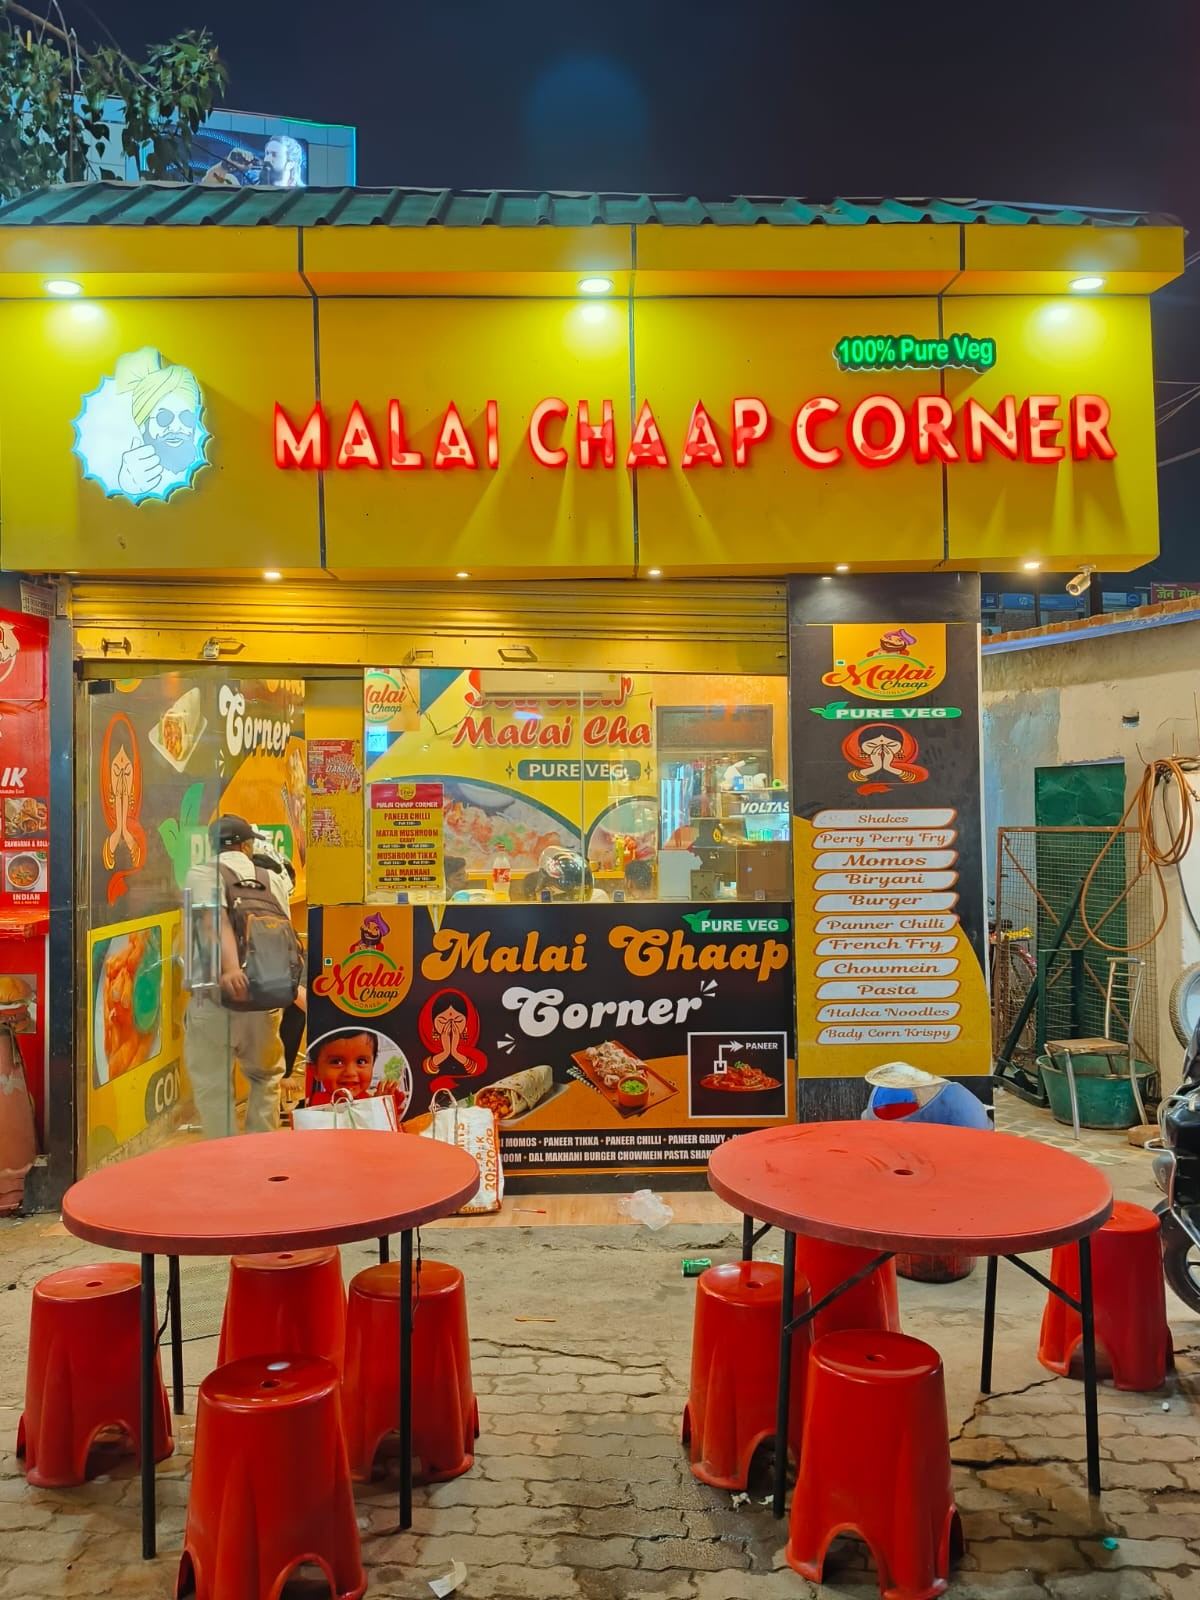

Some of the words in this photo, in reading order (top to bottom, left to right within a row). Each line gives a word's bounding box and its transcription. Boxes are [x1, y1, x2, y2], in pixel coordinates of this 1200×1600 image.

[839, 338, 895, 363] 100%
[901, 338, 949, 361] Pure
[953, 337, 993, 366] Veg
[273, 399, 499, 470] MALAI
[529, 397, 768, 470] CHAAP
[791, 393, 1117, 470] CORNER
[825, 664, 937, 690] Malai
[880, 679, 930, 691] Chaap
[371, 703, 402, 715] Chaap
[836, 708, 894, 719] PURE
[902, 707, 947, 718] VEG
[218, 684, 291, 756] Corner
[452, 715, 573, 746] Malai
[529, 763, 580, 777] PURE
[586, 763, 626, 777] VEG
[740, 801, 789, 814] VOLTAS
[409, 812, 430, 820] CHILLI
[858, 813, 910, 824] Shakes
[376, 829, 398, 837] MATAR
[400, 829, 438, 837] MUSHROOM
[820, 833, 865, 847] Perry
[869, 833, 915, 846] Perry
[919, 832, 947, 845] Fry
[376, 852, 416, 860] MUSHROOM
[418, 851, 438, 859] TIKKA
[842, 854, 927, 867] Momos
[385, 869, 398, 877] DAL
[845, 873, 925, 888] Biryani
[12, 893, 41, 901] INDIAN
[848, 894, 923, 909] Burger
[701, 920, 743, 932] PURE
[747, 919, 780, 931] VEG
[826, 919, 894, 930] Panner
[899, 919, 945, 929] Chilli
[829, 938, 901, 950] French
[905, 938, 943, 953] Fry
[421, 928, 588, 981] Malai
[608, 925, 789, 982] Chaap
[834, 962, 940, 975] Chowmein
[315, 963, 405, 1000] Malai
[360, 987, 400, 1002] Chaap
[857, 983, 919, 996] Pasta
[502, 986, 703, 1038] Corner
[826, 1007, 881, 1018] Hakka
[884, 1007, 950, 1017] Noodles
[825, 1028, 864, 1041] Bady
[868, 1028, 901, 1038] Corn
[904, 1027, 951, 1040] Krispy
[746, 1042, 779, 1050] PANEER
[505, 1137, 537, 1148] MOMOS
[543, 1136, 574, 1147] PANEER
[574, 1136, 599, 1146] TIKKA
[605, 1135, 636, 1146] PANEER
[636, 1135, 662, 1145] CHILLI
[668, 1135, 698, 1145] PANEER
[698, 1134, 726, 1144] GRAVY
[501, 1153, 522, 1163] OOM
[528, 1152, 545, 1162] DAL
[545, 1152, 583, 1162] MAKHANI
[583, 1151, 616, 1161] BURGER
[617, 1150, 663, 1160] CHOWMEIN
[663, 1150, 690, 1160] PASTA
[690, 1149, 713, 1160] SHAK
